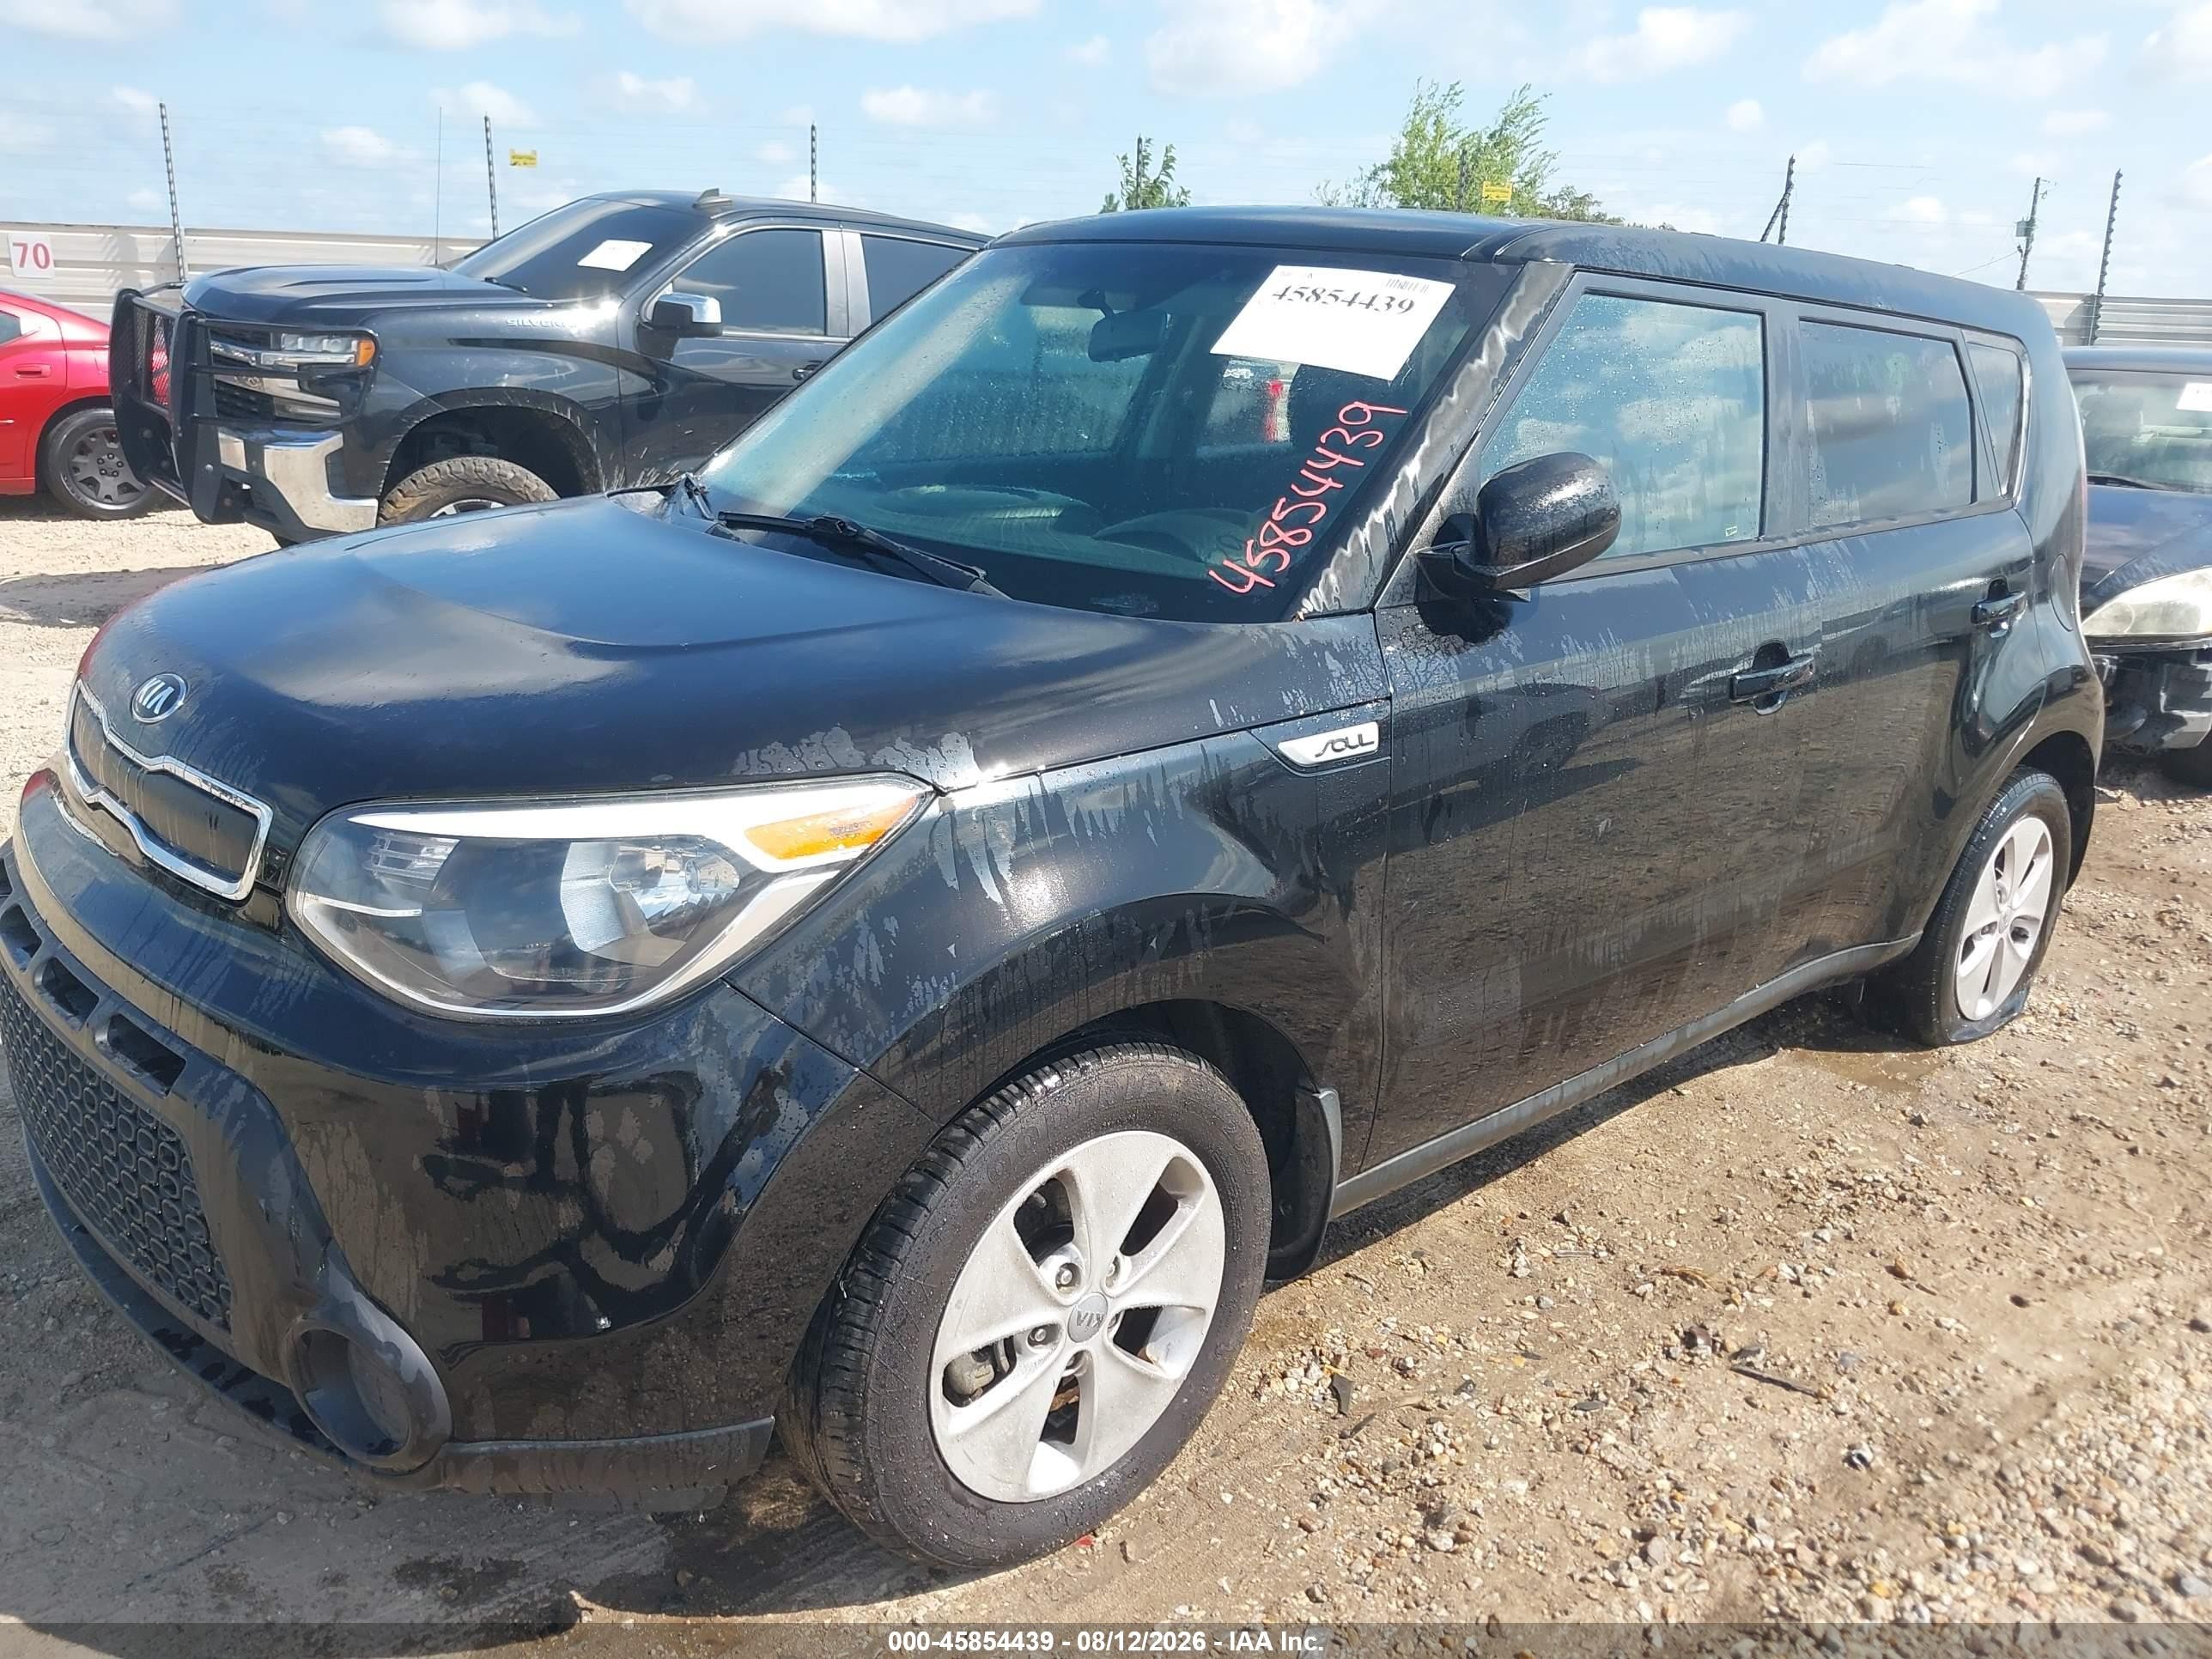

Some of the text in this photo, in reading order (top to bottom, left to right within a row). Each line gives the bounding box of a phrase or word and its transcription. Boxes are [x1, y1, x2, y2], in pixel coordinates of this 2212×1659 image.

[13, 242, 50, 270] 70
[1272, 284, 1415, 315] 45854439
[1208, 401, 1409, 593] 45854439
[1315, 733, 1375, 758] SOUL
